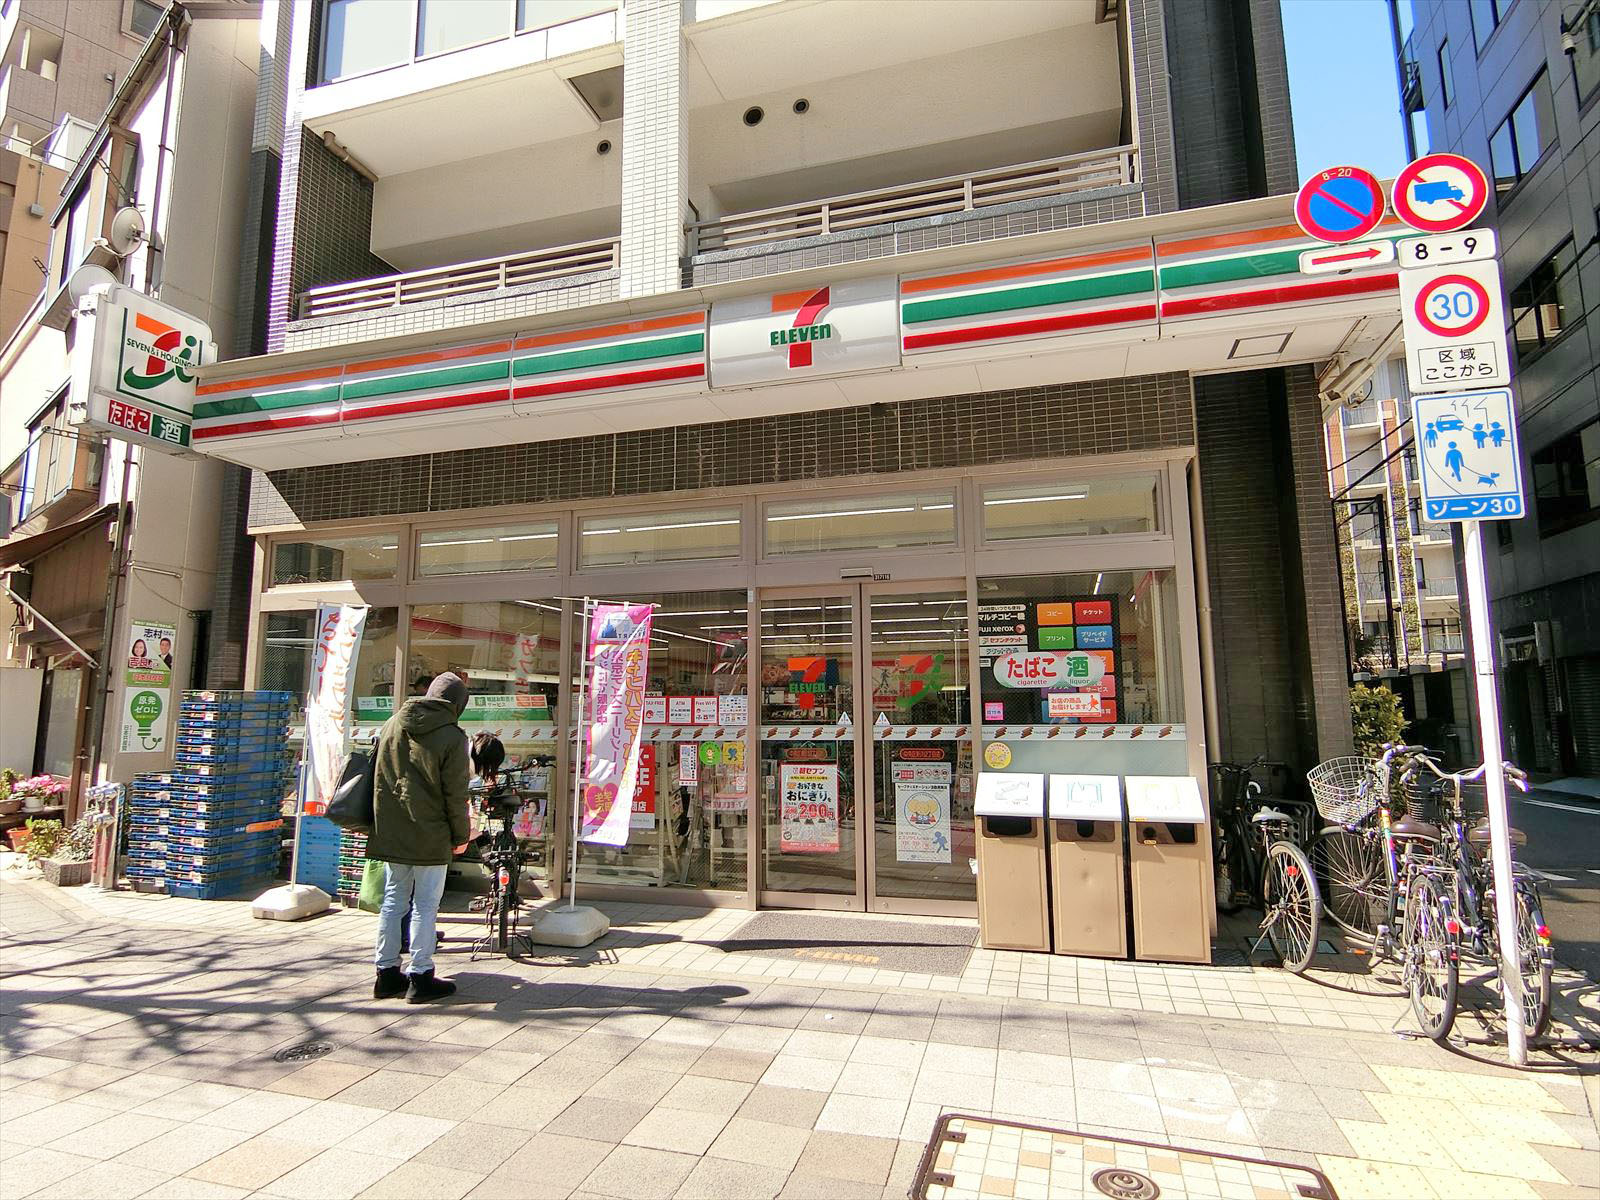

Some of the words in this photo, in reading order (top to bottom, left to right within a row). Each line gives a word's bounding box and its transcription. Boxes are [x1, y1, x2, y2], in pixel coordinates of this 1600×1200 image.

[1321, 167, 1353, 181] 8-20
[1432, 291, 1474, 321] 30
[770, 323, 832, 346] ELEVEN
[1438, 347, 1476, 364] 区域
[1425, 362, 1494, 381] ここから
[108, 402, 150, 434] たばこ
[160, 416, 182, 444] 酒
[1431, 498, 1517, 518] ゾーン30
[1007, 656, 1057, 679] たばこ
[1066, 656, 1089, 678] 酒
[1016, 678, 1048, 686] cigarette
[1069, 678, 1090, 686] liquor
[134, 705, 159, 714] ゼロに
